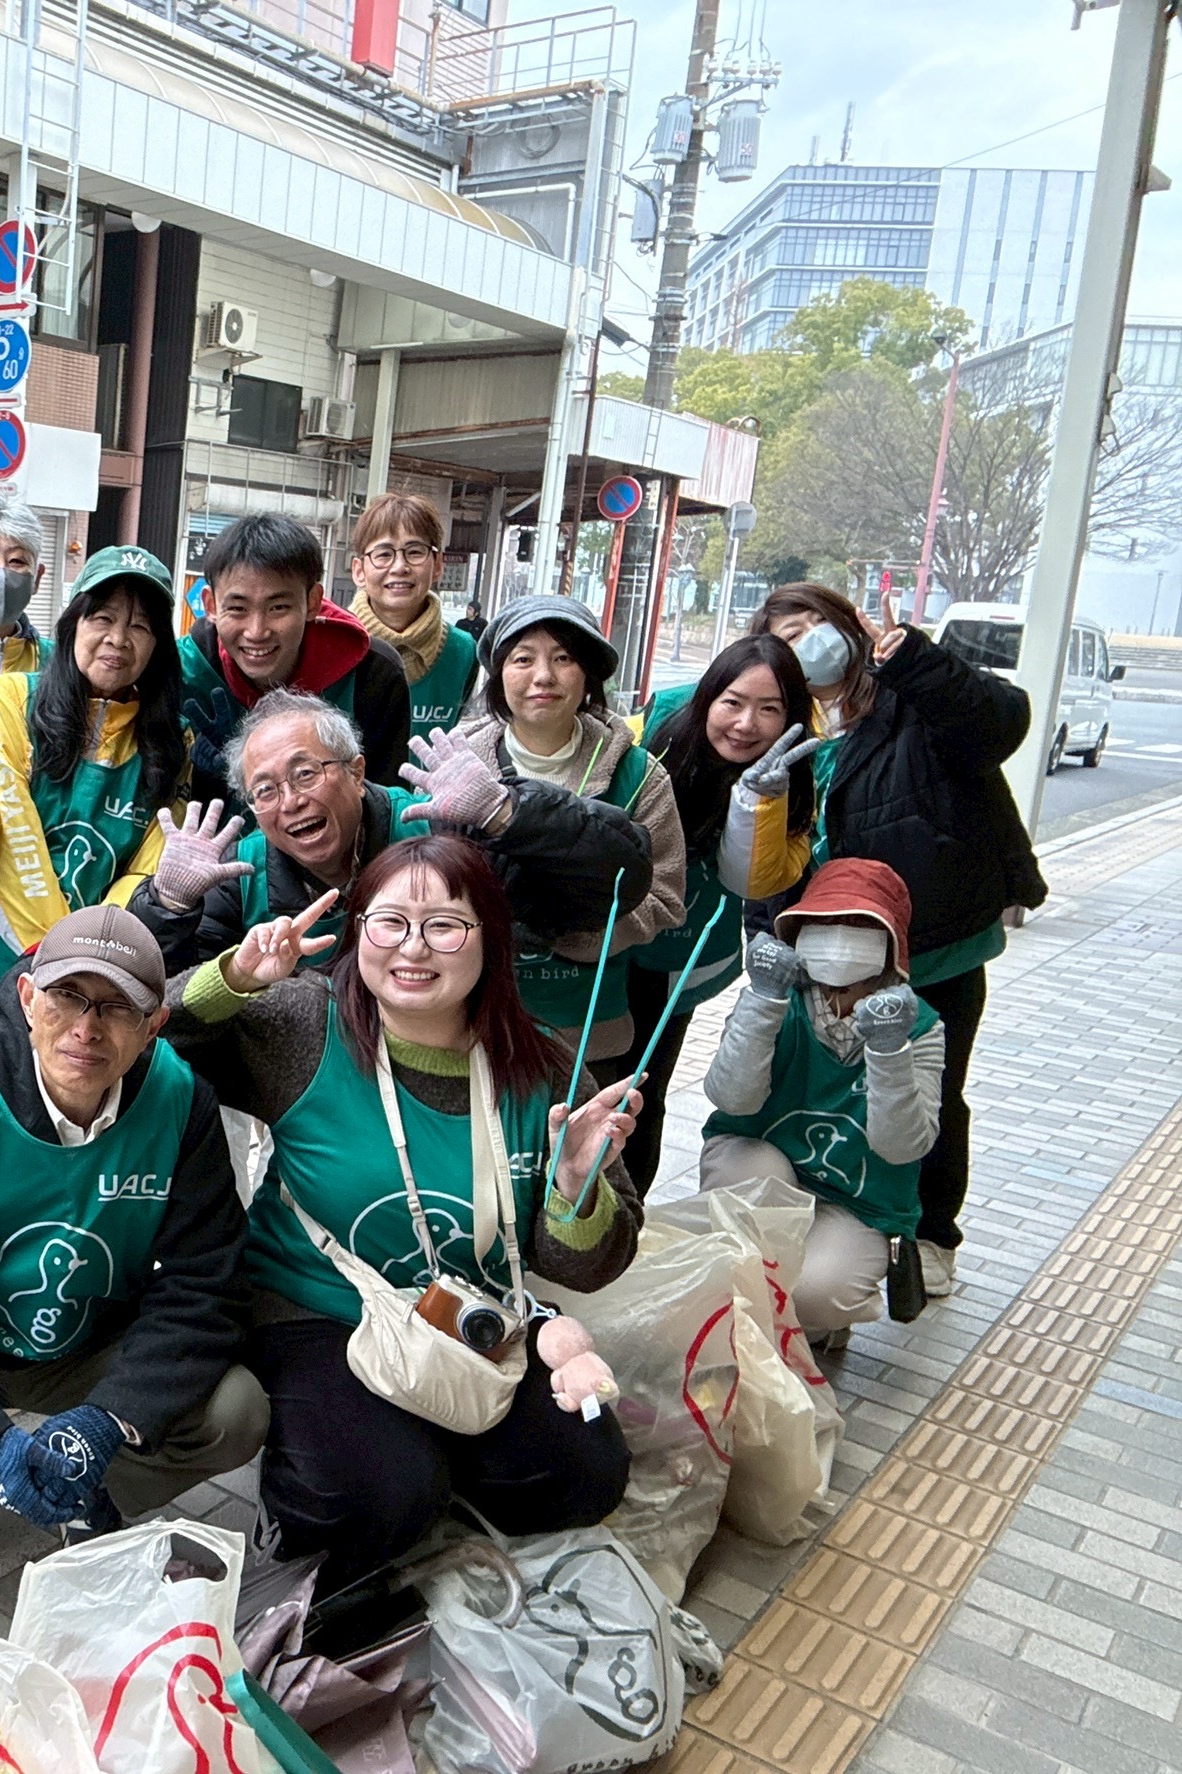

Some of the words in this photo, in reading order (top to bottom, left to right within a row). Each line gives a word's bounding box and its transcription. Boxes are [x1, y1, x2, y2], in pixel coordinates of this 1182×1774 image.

[2, 359, 18, 380] 60
[6, 825, 49, 898] MEIJI
[541, 965, 580, 980] bird
[98, 1174, 172, 1201] UACJ
